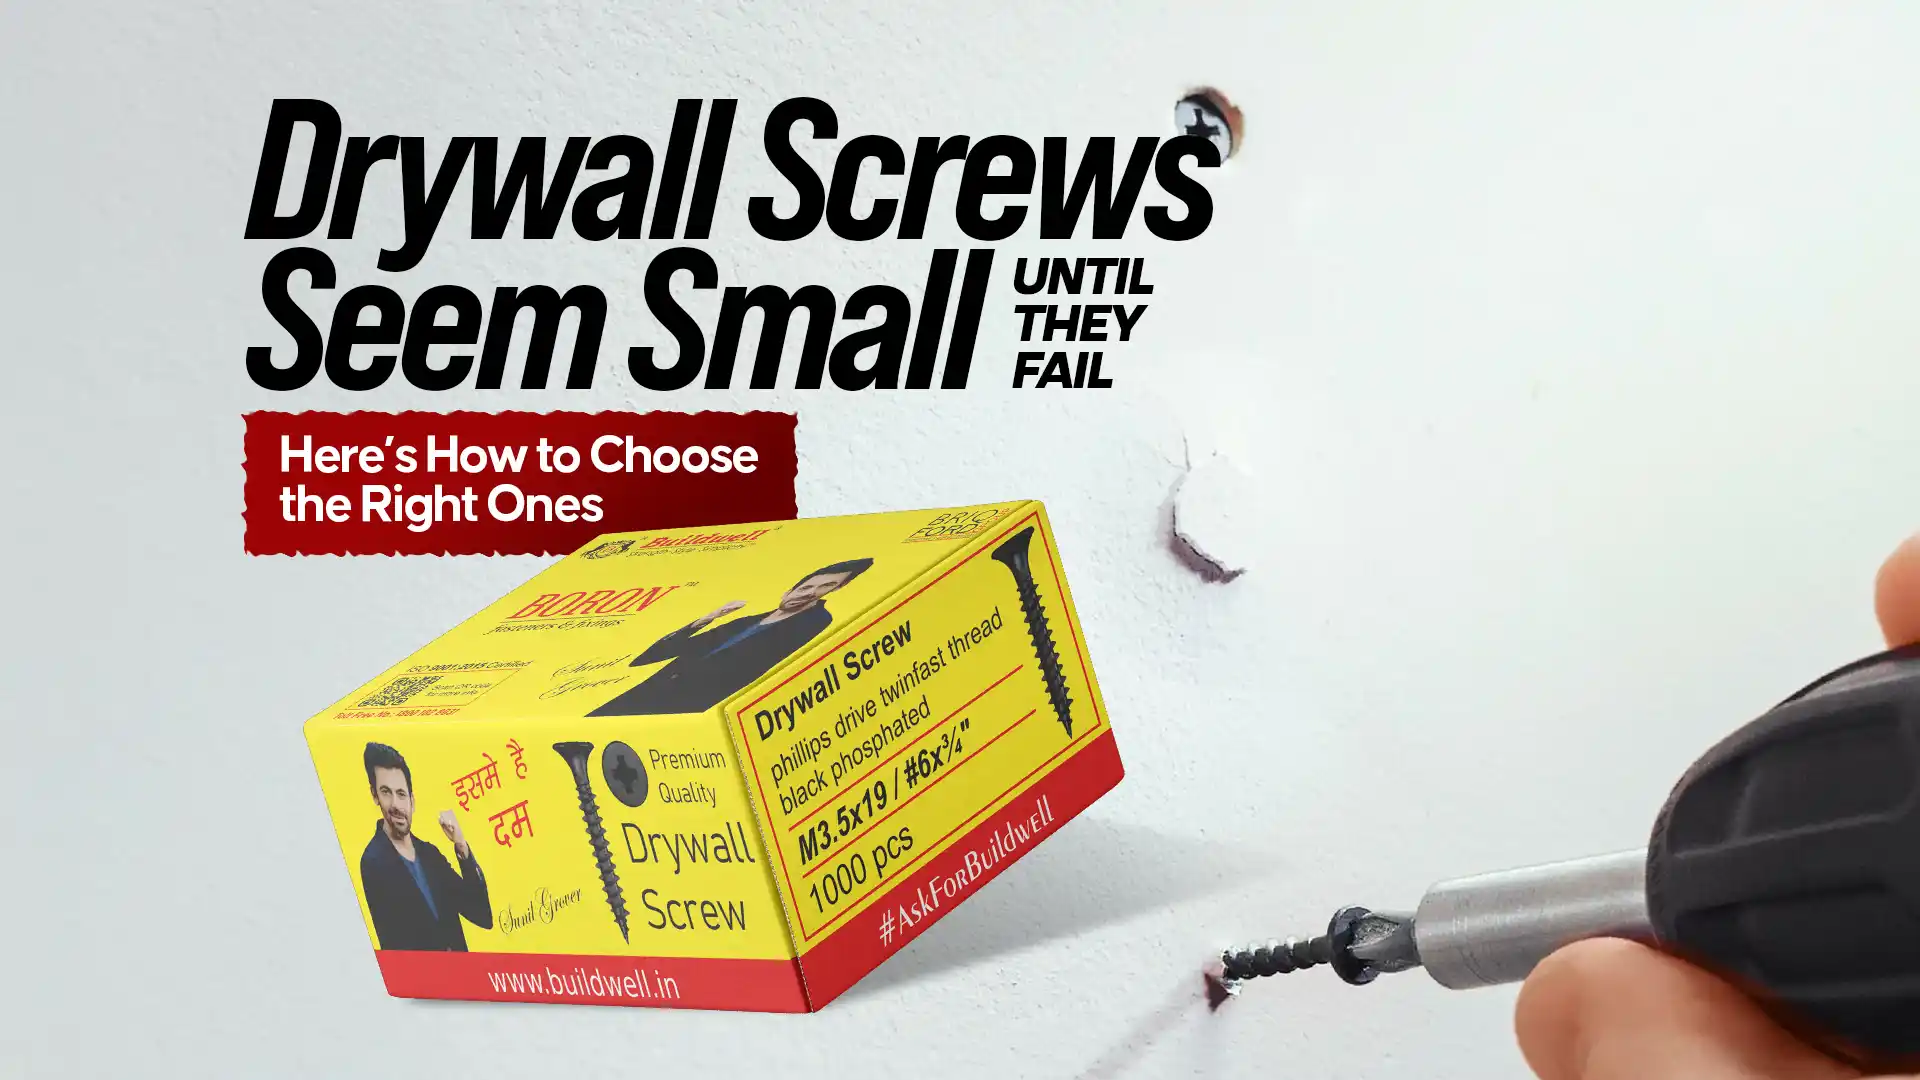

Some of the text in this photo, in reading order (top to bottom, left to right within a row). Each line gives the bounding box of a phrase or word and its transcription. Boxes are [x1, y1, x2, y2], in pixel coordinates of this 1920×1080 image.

[639, 529, 771, 549] Buildwell
[909, 523, 979, 539] FORD
[505, 585, 681, 620] BORON
[754, 619, 912, 742] Drywall Screw
[770, 605, 1003, 789] phillips drive twinfast thread
[505, 738, 528, 780] है
[648, 748, 727, 770] Premium
[778, 695, 932, 816] black phosphated
[658, 782, 717, 809] Quality
[487, 799, 534, 849] दम
[798, 780, 888, 866] M3.5x19
[621, 821, 756, 875] Drywall
[809, 826, 914, 914] 1000 pcs
[498, 901, 535, 935] Sunil
[641, 888, 747, 932] Screw
[487, 966, 681, 1000] www.buildwell.in
